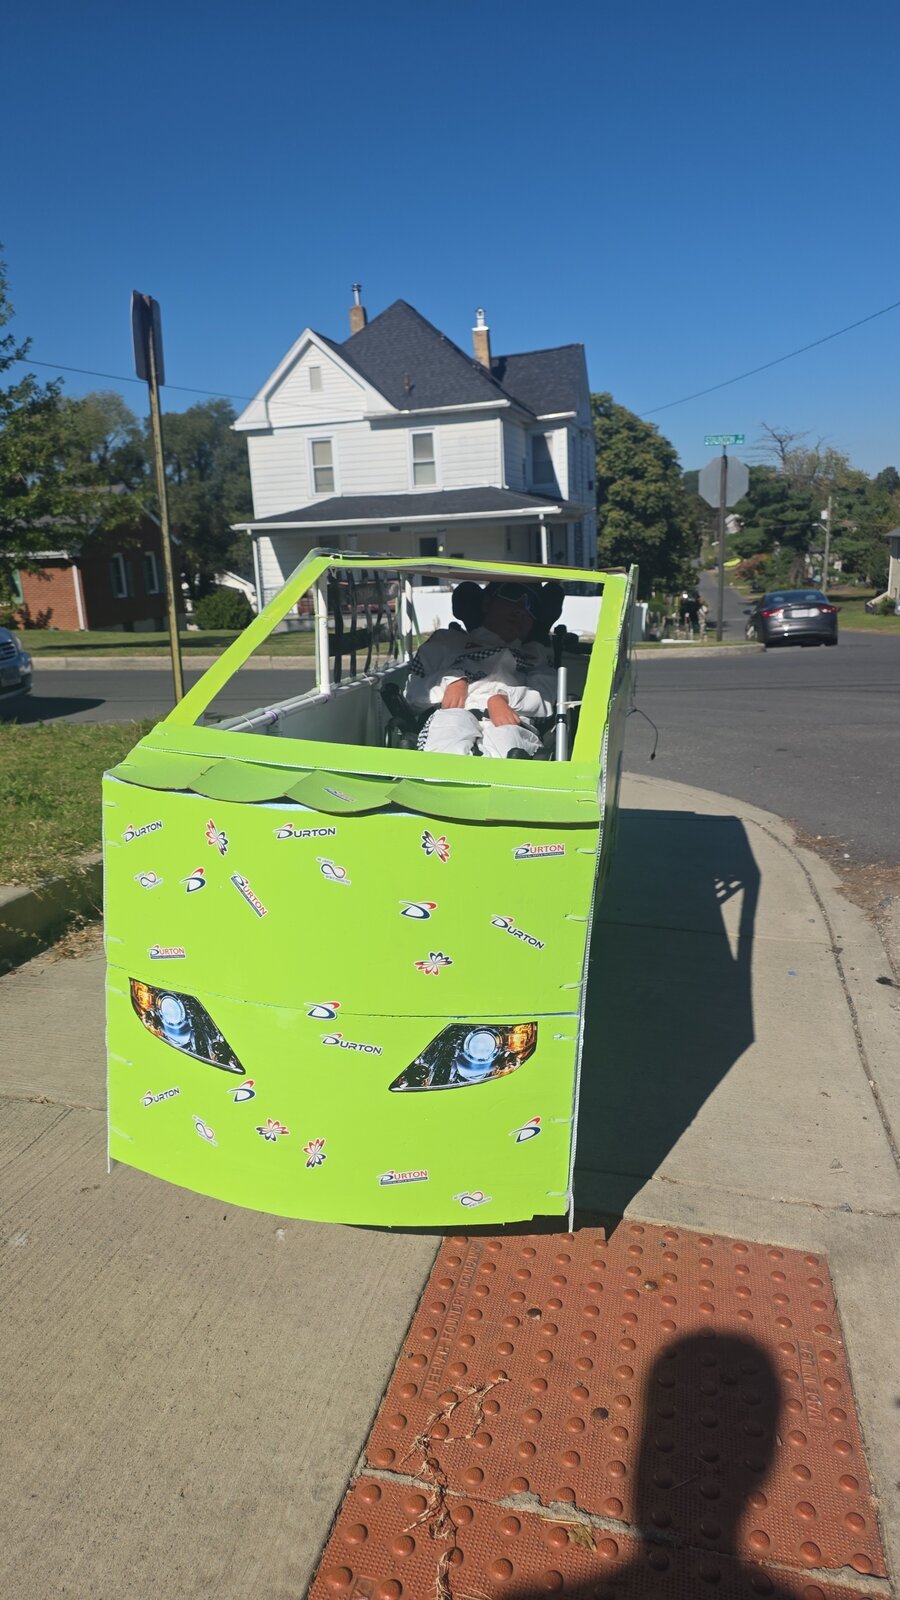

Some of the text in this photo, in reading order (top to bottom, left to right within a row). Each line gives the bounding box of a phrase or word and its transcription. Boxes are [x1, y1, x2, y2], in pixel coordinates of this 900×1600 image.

[274, 823, 336, 839] BURTON
[491, 914, 545, 949] BURTON
[322, 1033, 382, 1055] BURTON
